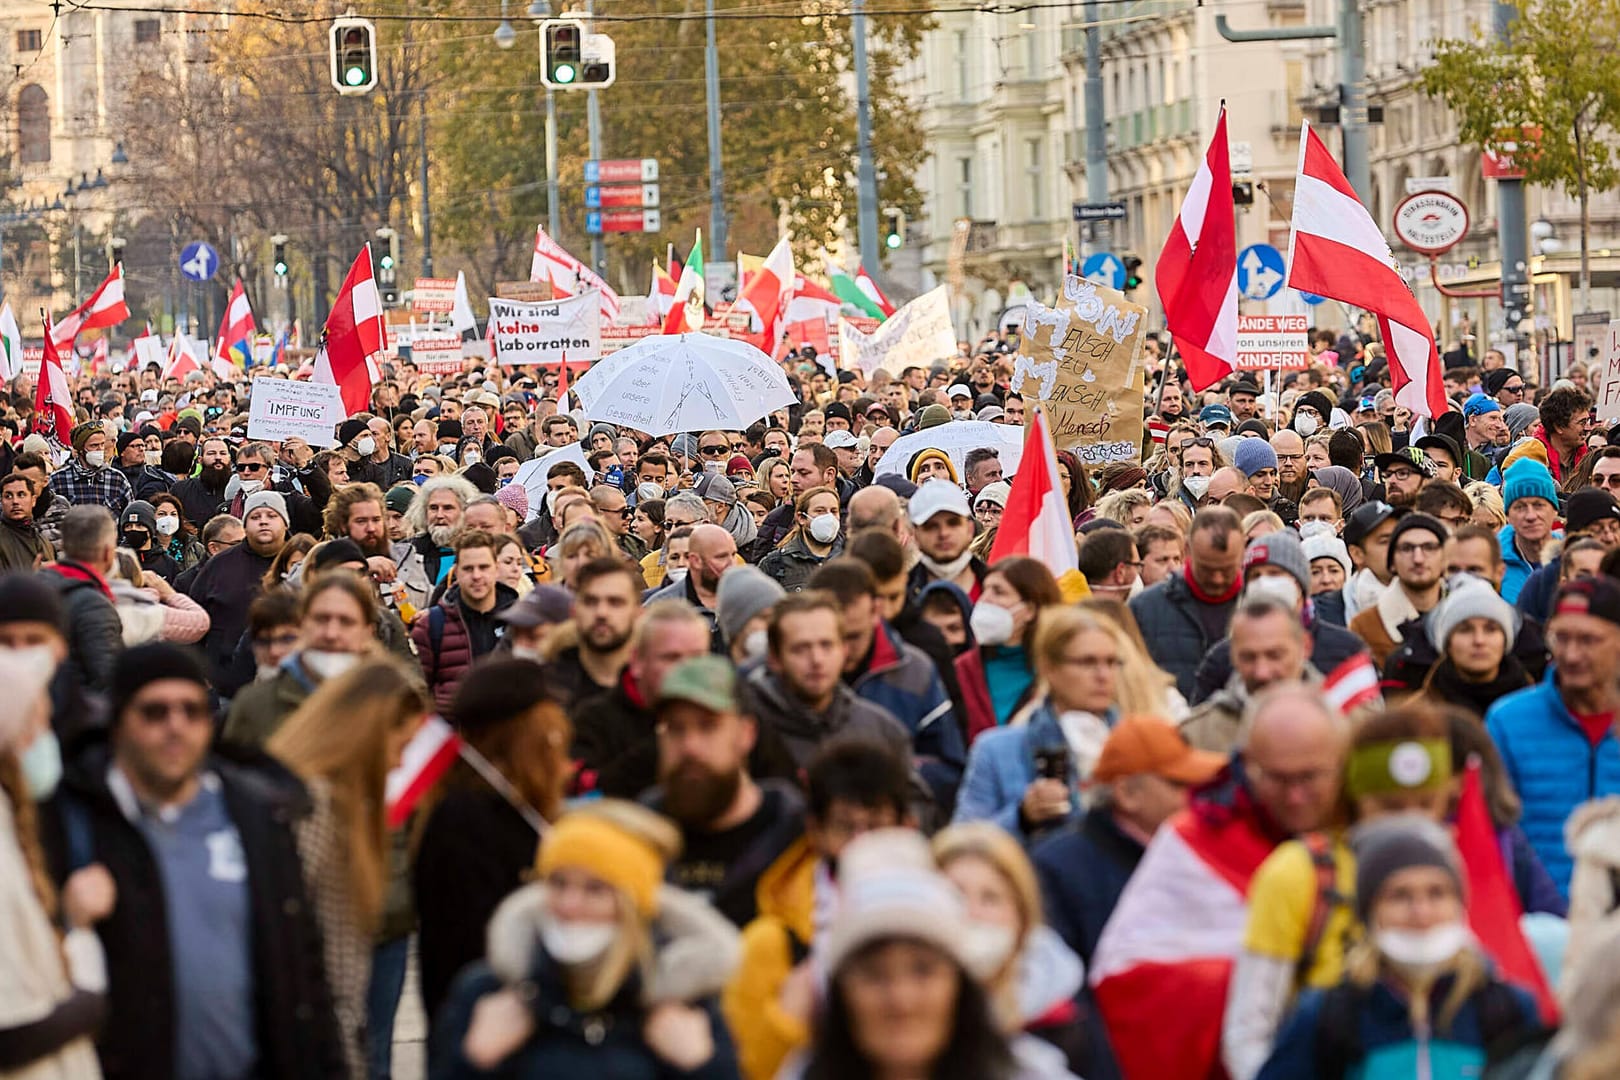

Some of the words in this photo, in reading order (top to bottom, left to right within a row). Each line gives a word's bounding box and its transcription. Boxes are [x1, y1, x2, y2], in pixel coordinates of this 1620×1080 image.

[494, 305, 524, 317] Wir
[528, 305, 559, 317] sind
[497, 321, 539, 334] keine
[1237, 316, 1275, 330] ÄNDE
[1276, 318, 1306, 330] WEG
[1258, 339, 1304, 348] unseren
[1060, 355, 1088, 374] ZU
[605, 404, 653, 425] Gesundheit
[1052, 409, 1110, 441] Mensch
